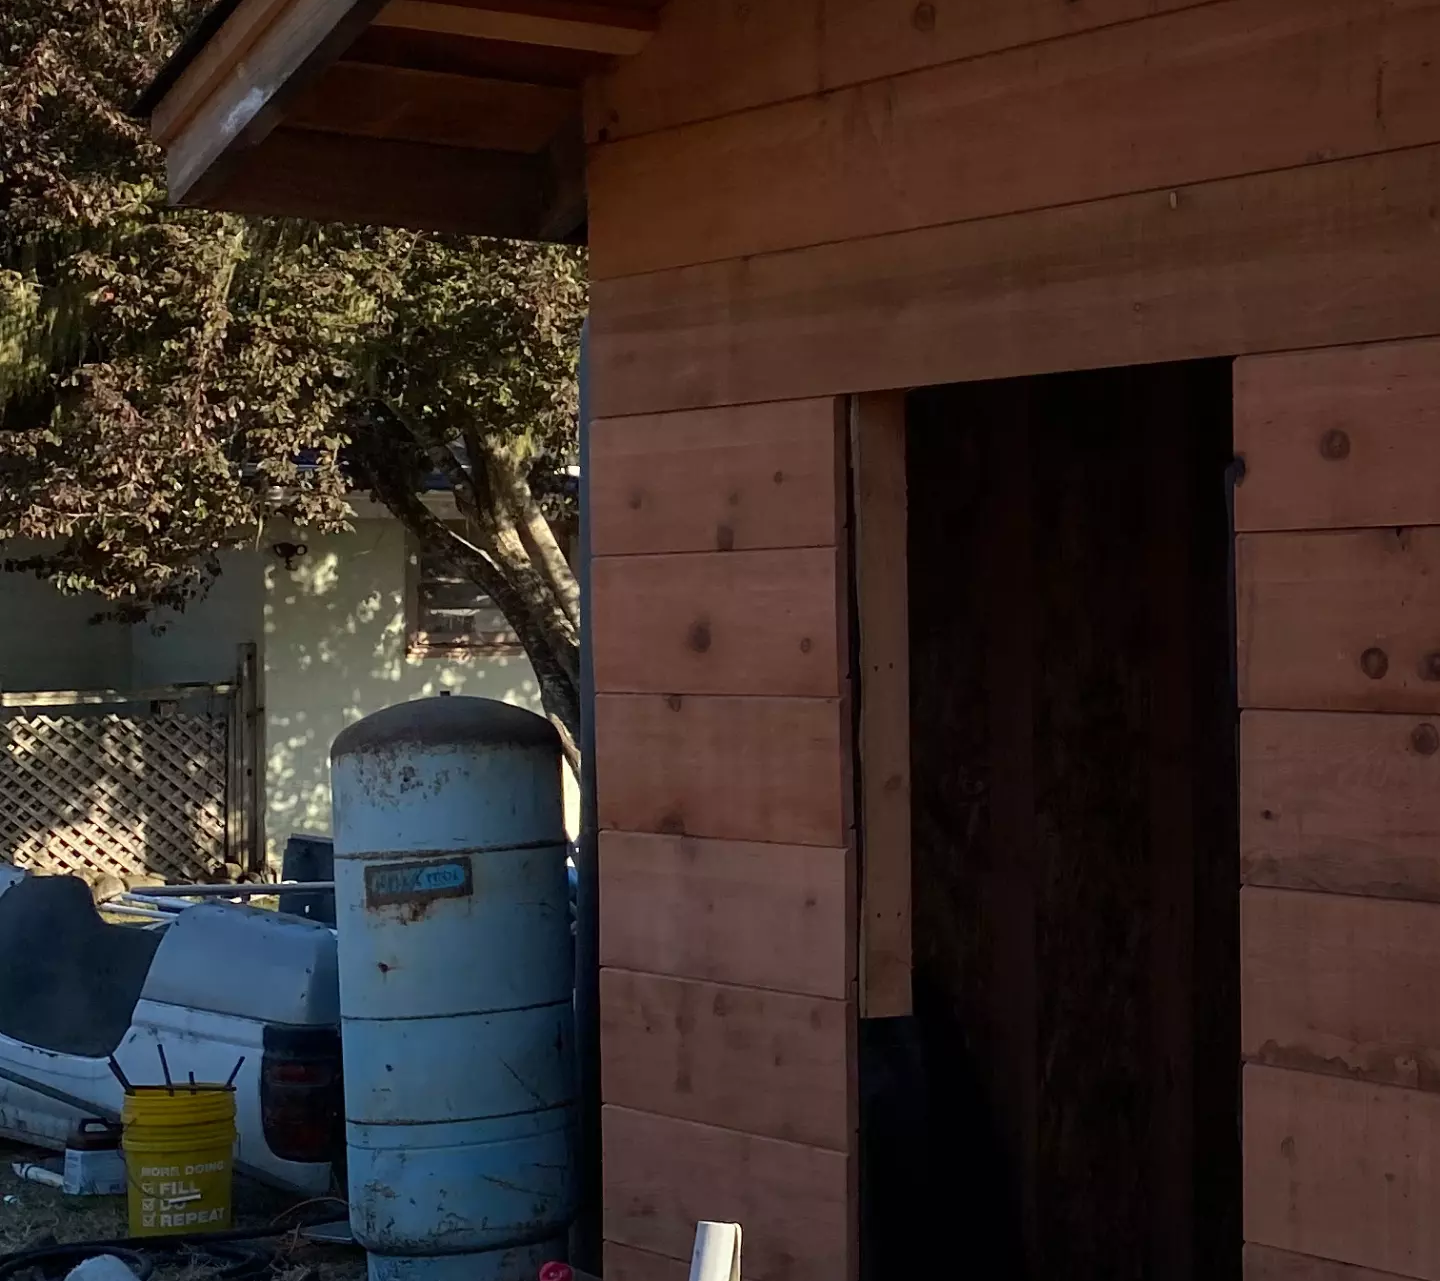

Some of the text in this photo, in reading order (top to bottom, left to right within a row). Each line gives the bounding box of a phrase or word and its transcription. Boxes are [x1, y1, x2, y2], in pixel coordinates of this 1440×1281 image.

[141, 1160, 224, 1177] MORE DOING
[159, 1181, 200, 1195] FILL
[160, 1207, 225, 1227] REPEAT
